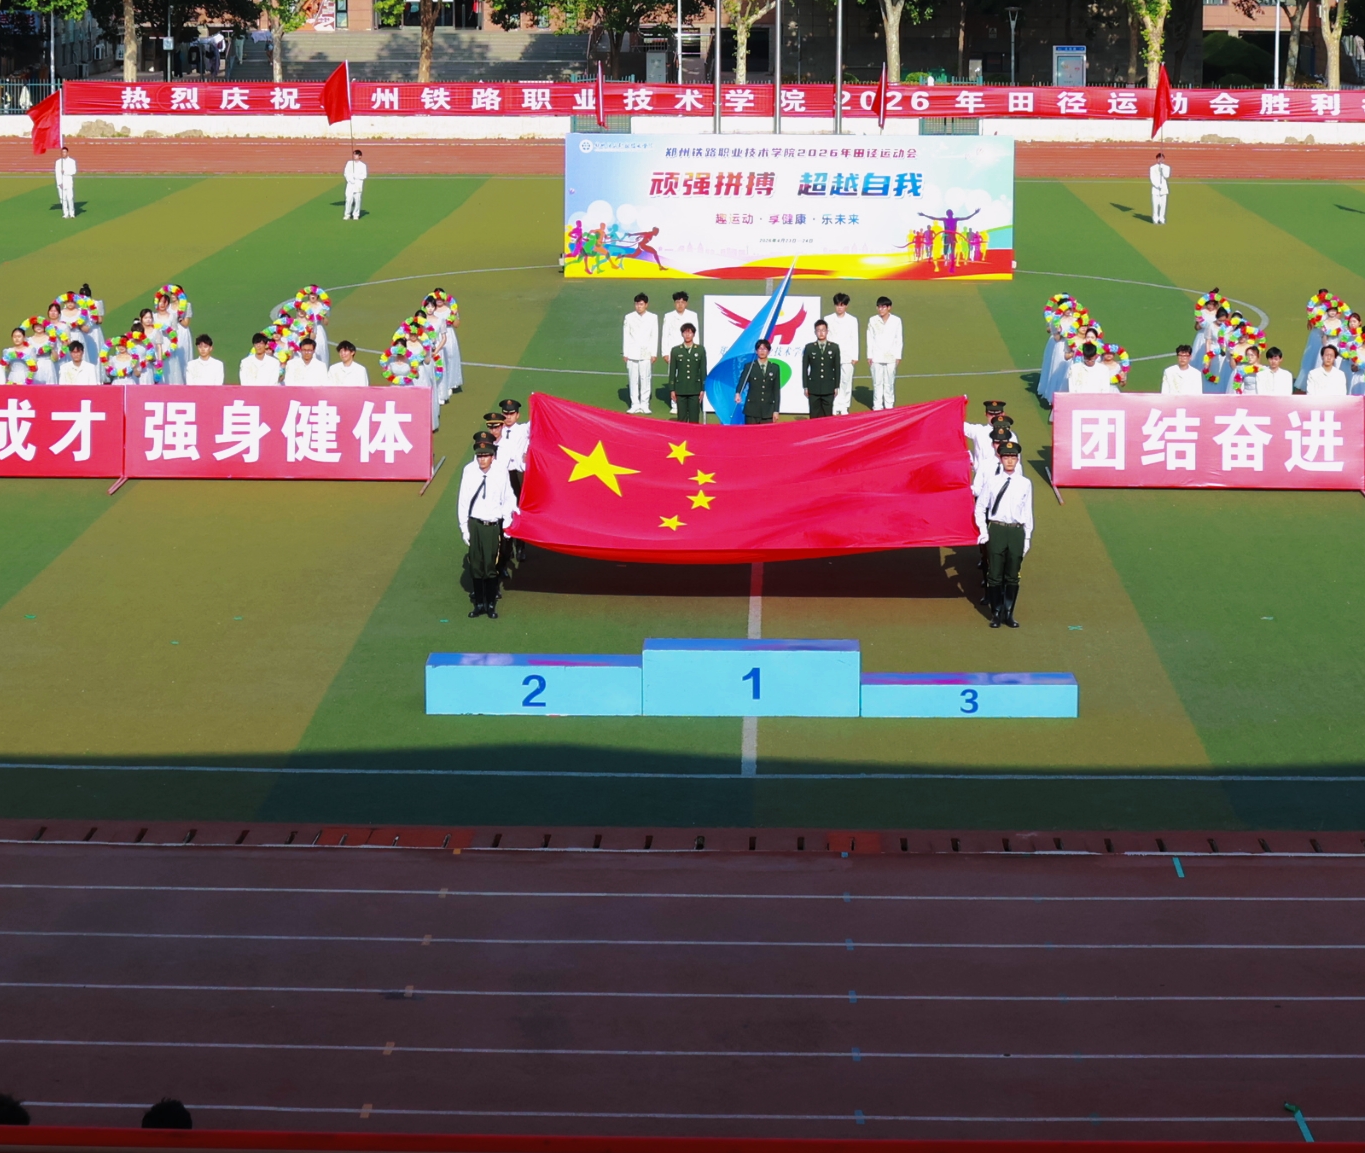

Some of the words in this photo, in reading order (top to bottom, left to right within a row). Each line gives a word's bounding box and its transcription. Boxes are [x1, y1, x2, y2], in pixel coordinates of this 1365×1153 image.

[665, 147, 918, 159] 郑州铁路职业技术学院2026年田径运动会
[649, 171, 776, 196] 顽强拼搏
[797, 171, 924, 197] 超越自我
[144, 399, 414, 465] 强身健体
[1070, 407, 1345, 473] 团结奋进
[521, 674, 548, 708] 2
[740, 667, 763, 701] 1
[958, 688, 980, 715] 3
